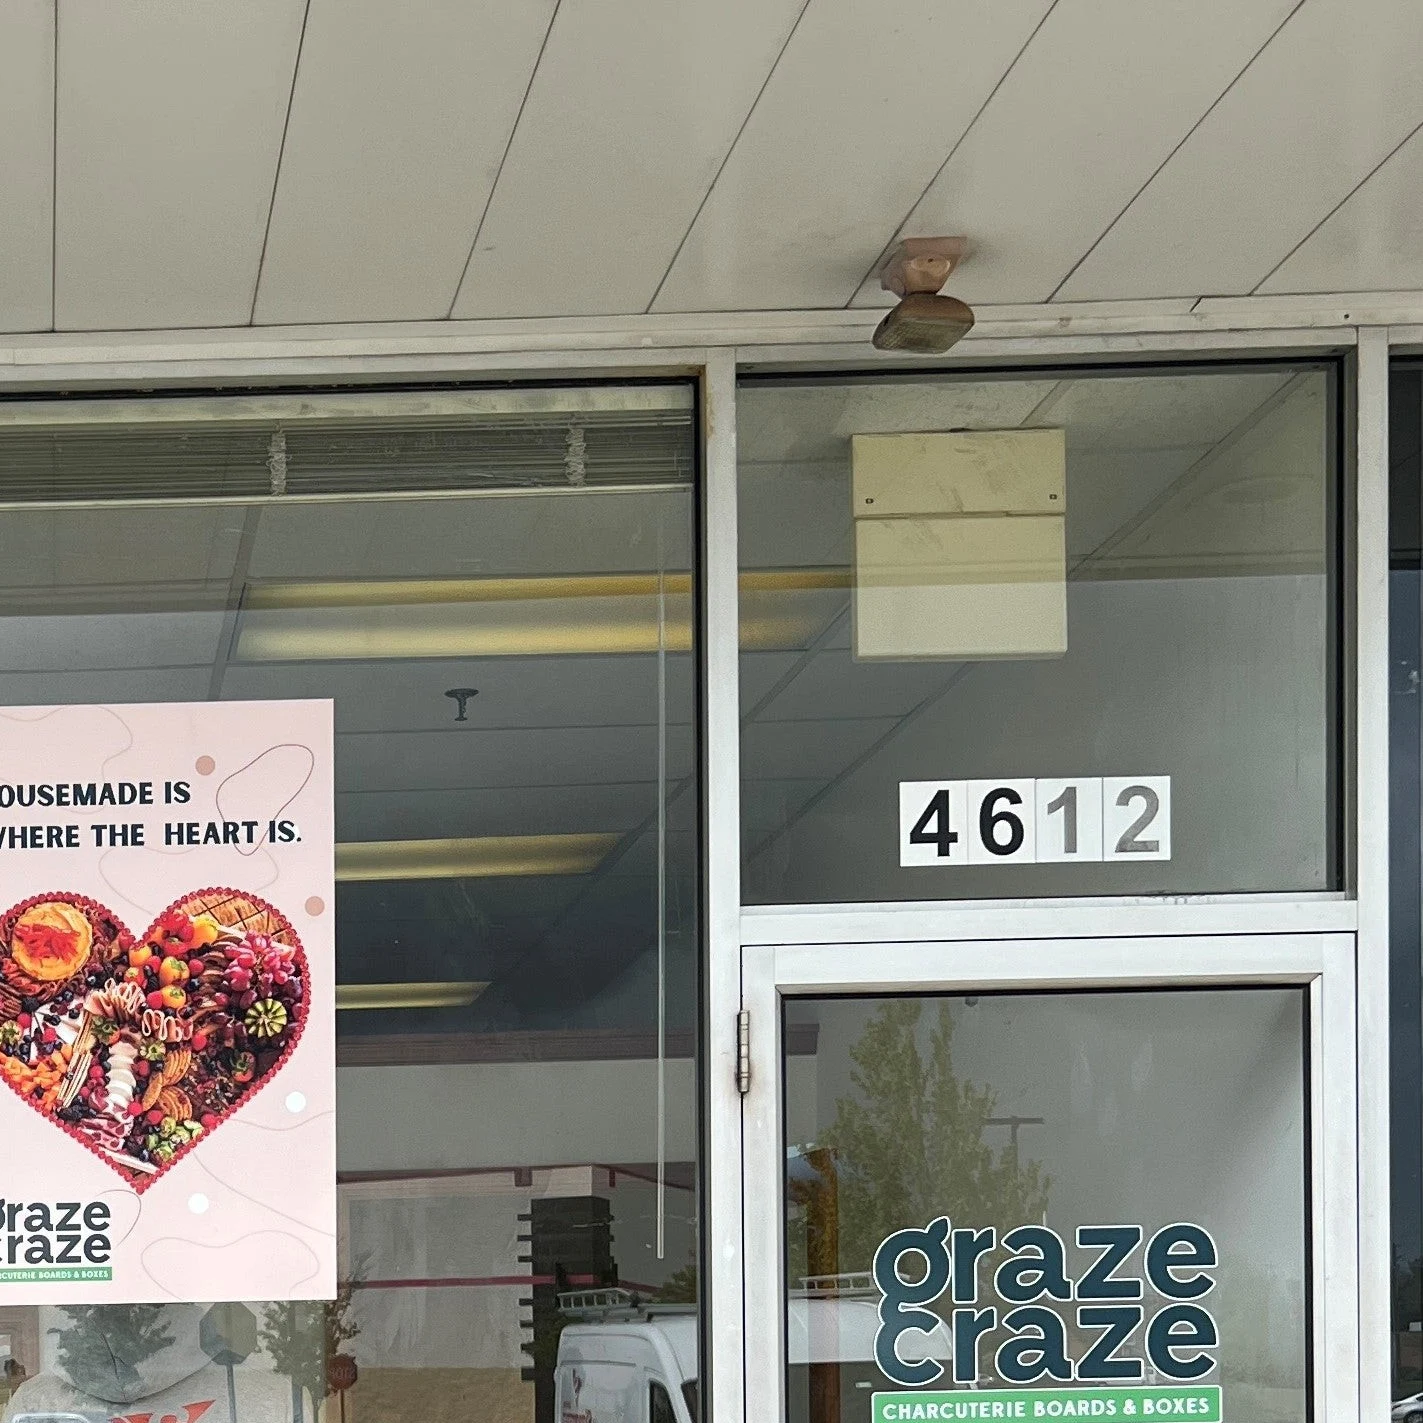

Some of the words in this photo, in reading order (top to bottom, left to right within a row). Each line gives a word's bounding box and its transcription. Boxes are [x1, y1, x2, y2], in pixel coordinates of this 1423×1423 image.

[164, 781, 191, 804] IS
[91, 823, 145, 847] THE
[165, 820, 258, 845] HEART
[269, 820, 302, 844] IS.
[910, 784, 1160, 857] 4612
[873, 1215, 1219, 1304] graze
[38, 1270, 71, 1279] BOARDS
[81, 1269, 109, 1278] BOXES
[874, 1303, 1220, 1386] craze
[882, 1402, 1026, 1420] CHARCUTERIE
[1033, 1400, 1117, 1417] BOARDS
[1122, 1399, 1137, 1415] &
[1143, 1397, 1210, 1415] BOXES
